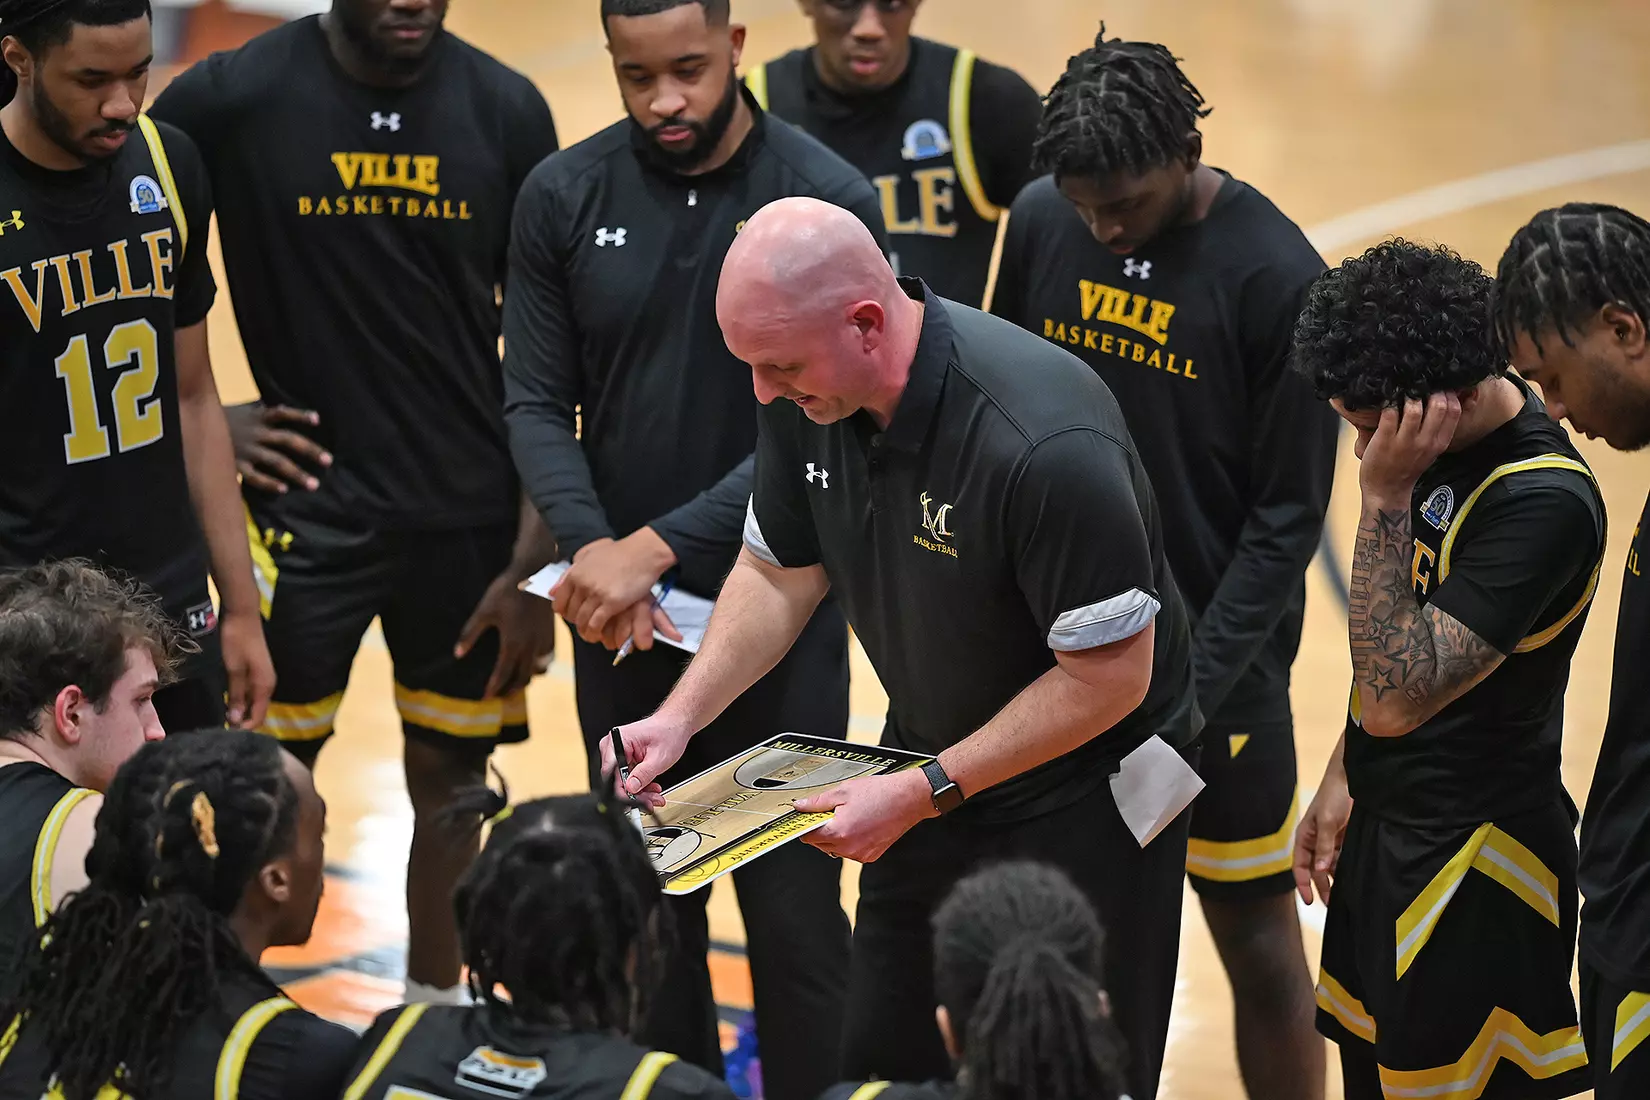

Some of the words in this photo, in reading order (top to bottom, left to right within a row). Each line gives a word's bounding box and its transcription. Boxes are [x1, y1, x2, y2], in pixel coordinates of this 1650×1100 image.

[330, 151, 441, 197] VILLE
[298, 195, 473, 220] BASKETBALL
[0, 227, 175, 334] VILLE
[1078, 278, 1177, 346] VILLE
[1043, 318, 1198, 380] BASKETBALL
[54, 317, 164, 465] 12
[913, 534, 958, 558] BASKETBALL
[768, 741, 897, 767] MILLERSVILLE
[731, 823, 805, 861] UNIVERSITY
